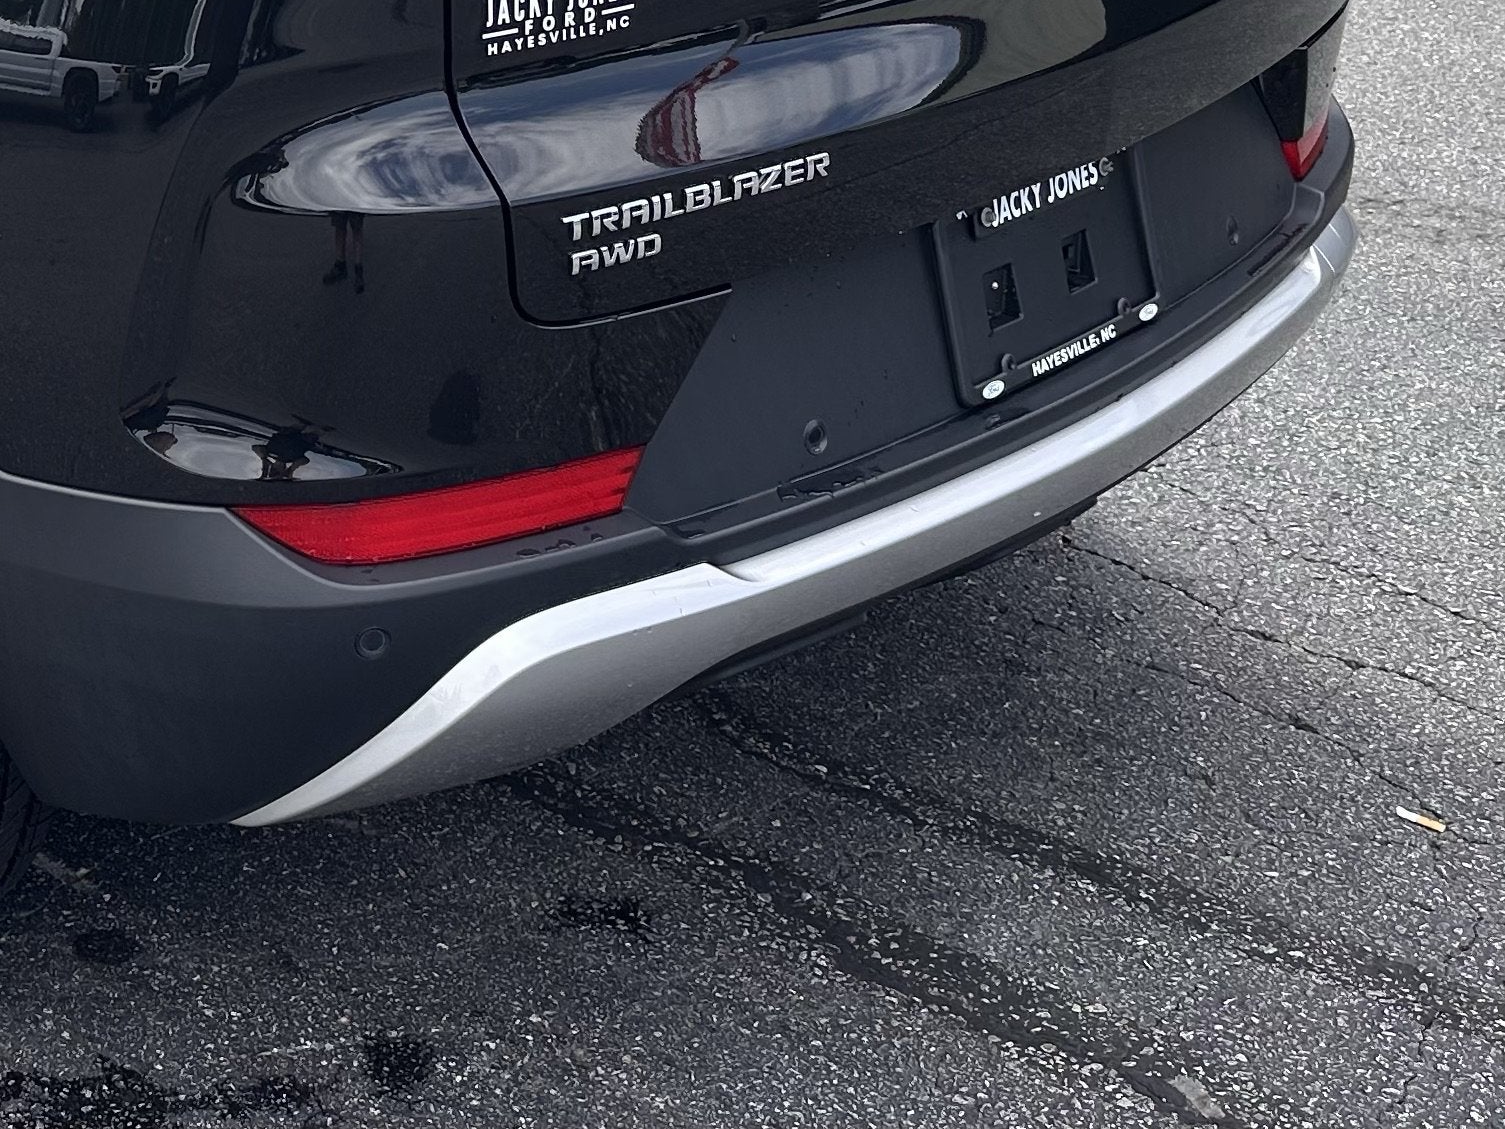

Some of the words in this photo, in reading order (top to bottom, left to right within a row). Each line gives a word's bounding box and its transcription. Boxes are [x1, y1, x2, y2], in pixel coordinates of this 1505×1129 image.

[524, 7, 596, 36] FORD
[560, 152, 831, 241] TRAILBLAZER
[991, 182, 1042, 227] JACKY
[1047, 161, 1099, 203] JONES
[571, 233, 662, 275] AWD
[1031, 333, 1100, 377] HAYESVILLE,
[1100, 324, 1117, 344] NC
